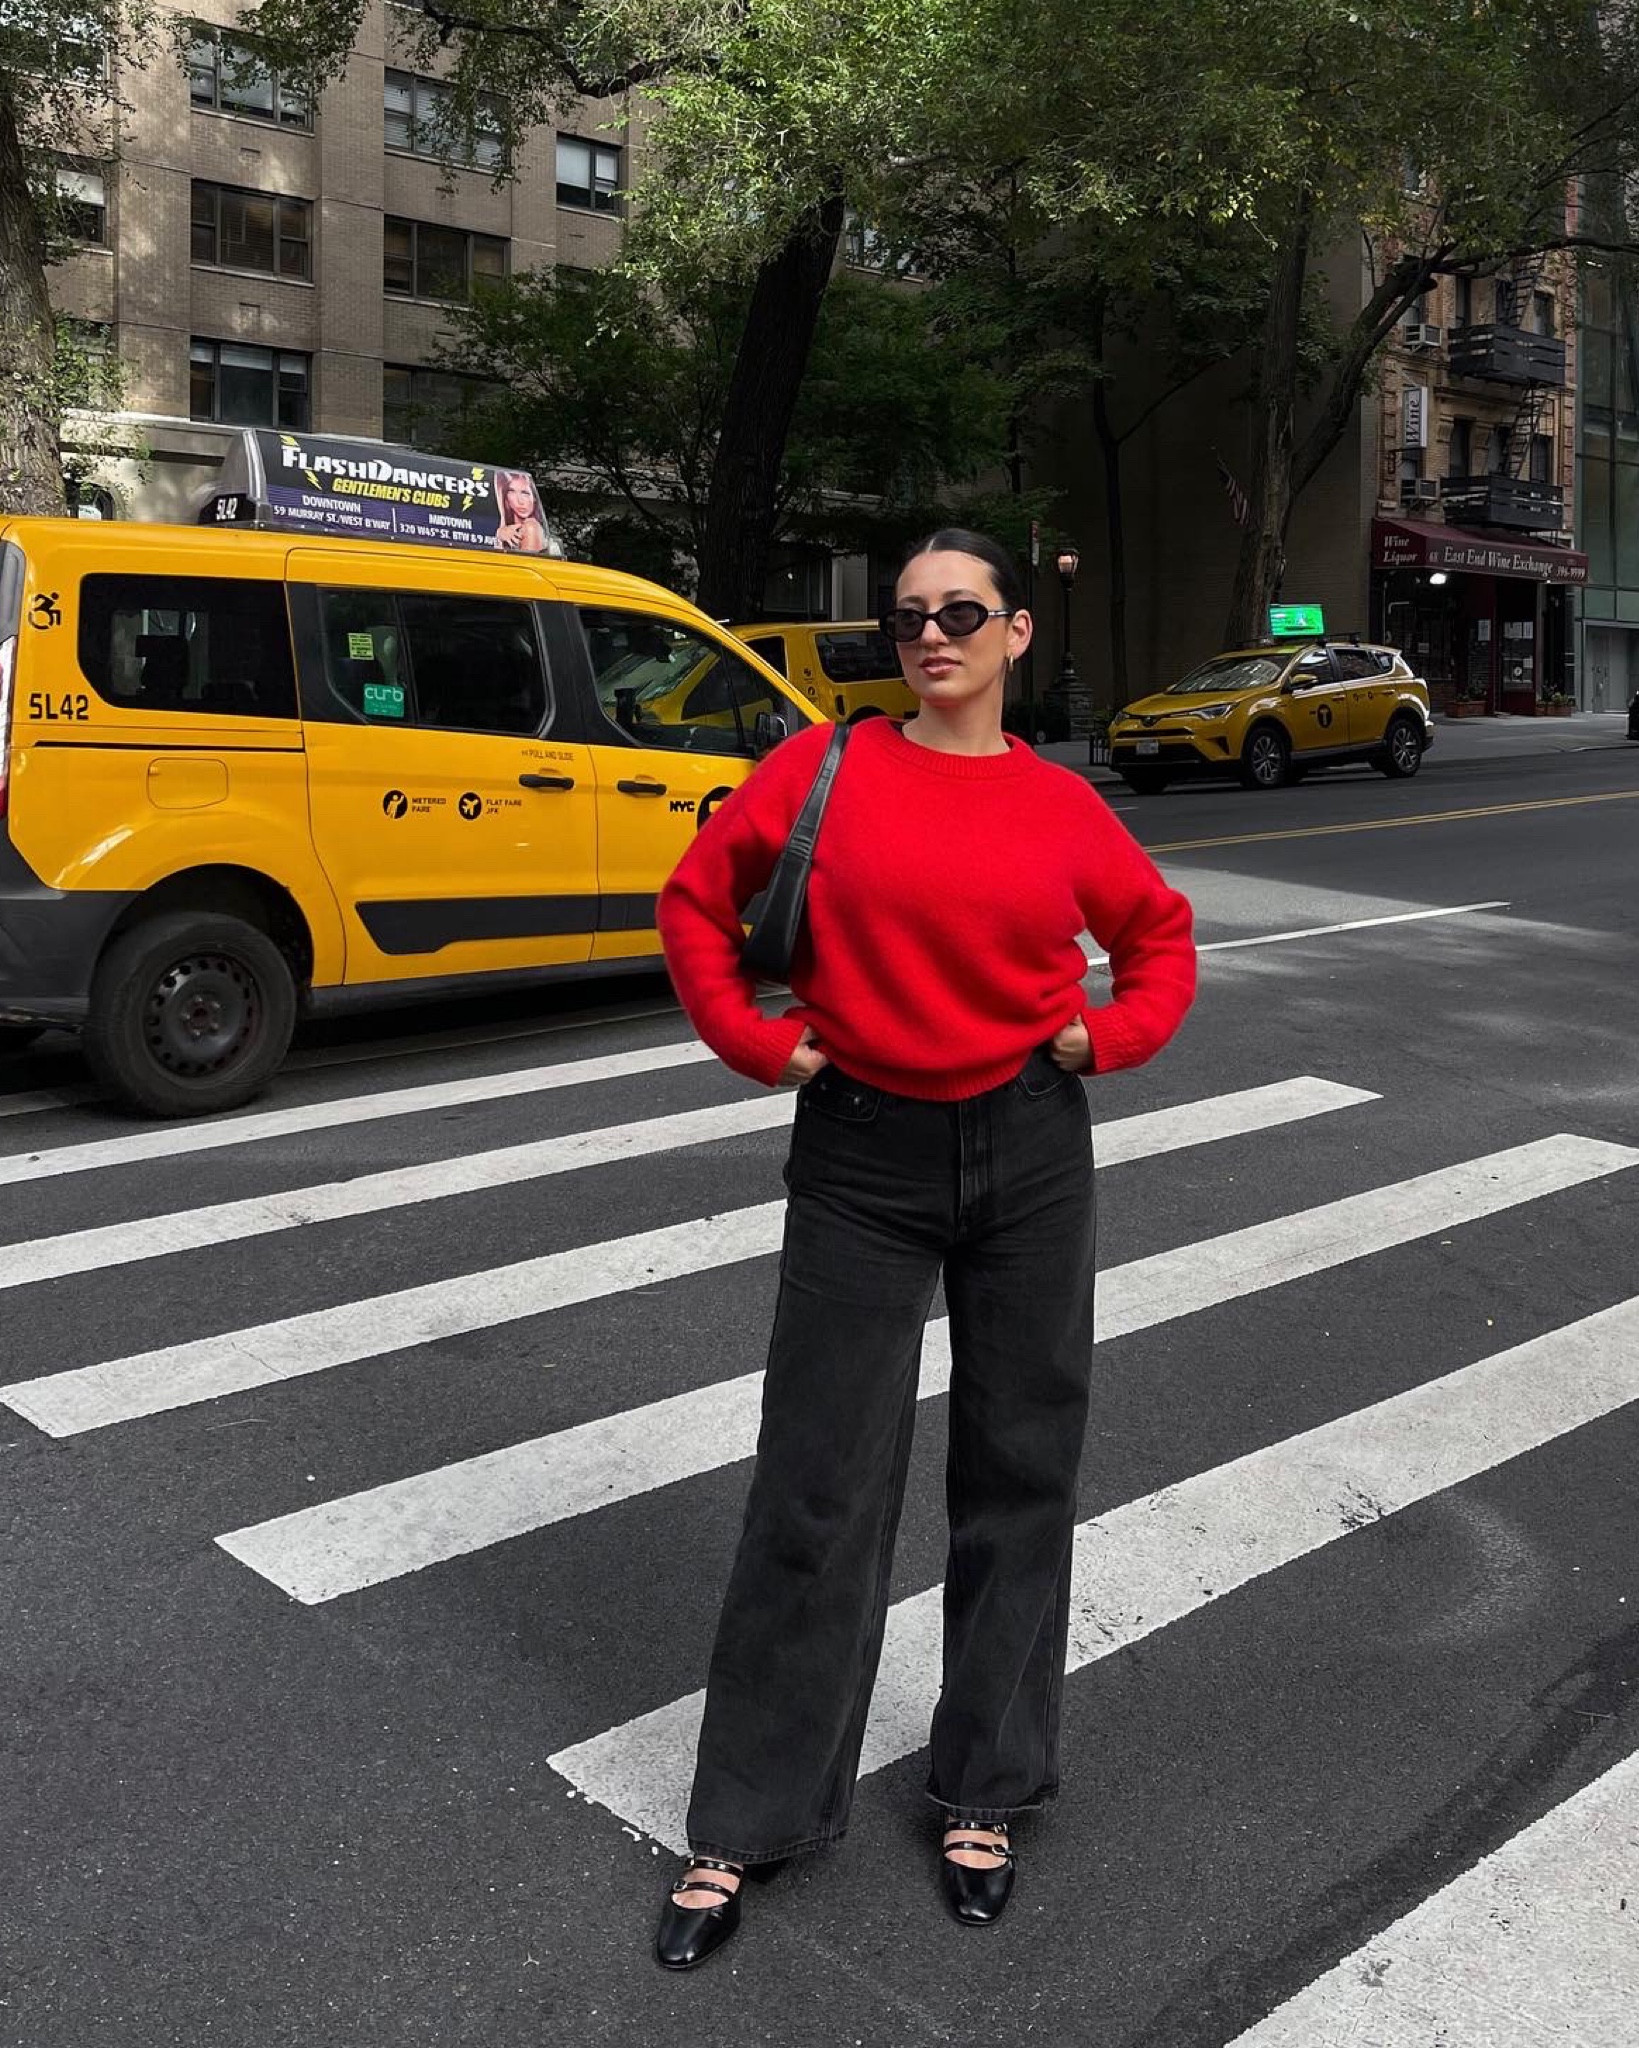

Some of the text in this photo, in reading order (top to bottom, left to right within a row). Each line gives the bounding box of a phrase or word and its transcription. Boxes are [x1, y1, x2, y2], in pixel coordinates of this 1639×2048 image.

[1406, 400, 1420, 443] Wine
[332, 478, 451, 509] GENTLEMEN'S CLUBS
[302, 495, 361, 514] DOWNTOWN
[274, 505, 286, 516] 59
[288, 507, 324, 521] MURRAY
[399, 523, 416, 535] 320
[428, 513, 472, 530] MIDTOWN
[1384, 535, 1410, 548] Wine
[1383, 551, 1419, 566] Liquor
[1444, 546, 1465, 564] East
[1466, 548, 1486, 567] End
[1488, 551, 1512, 570] Wine
[1513, 554, 1553, 578] Exchange
[364, 686, 404, 702] curb
[29, 693, 90, 720] 5L42
[411, 797, 447, 805] METERED
[669, 800, 695, 812] NYC
